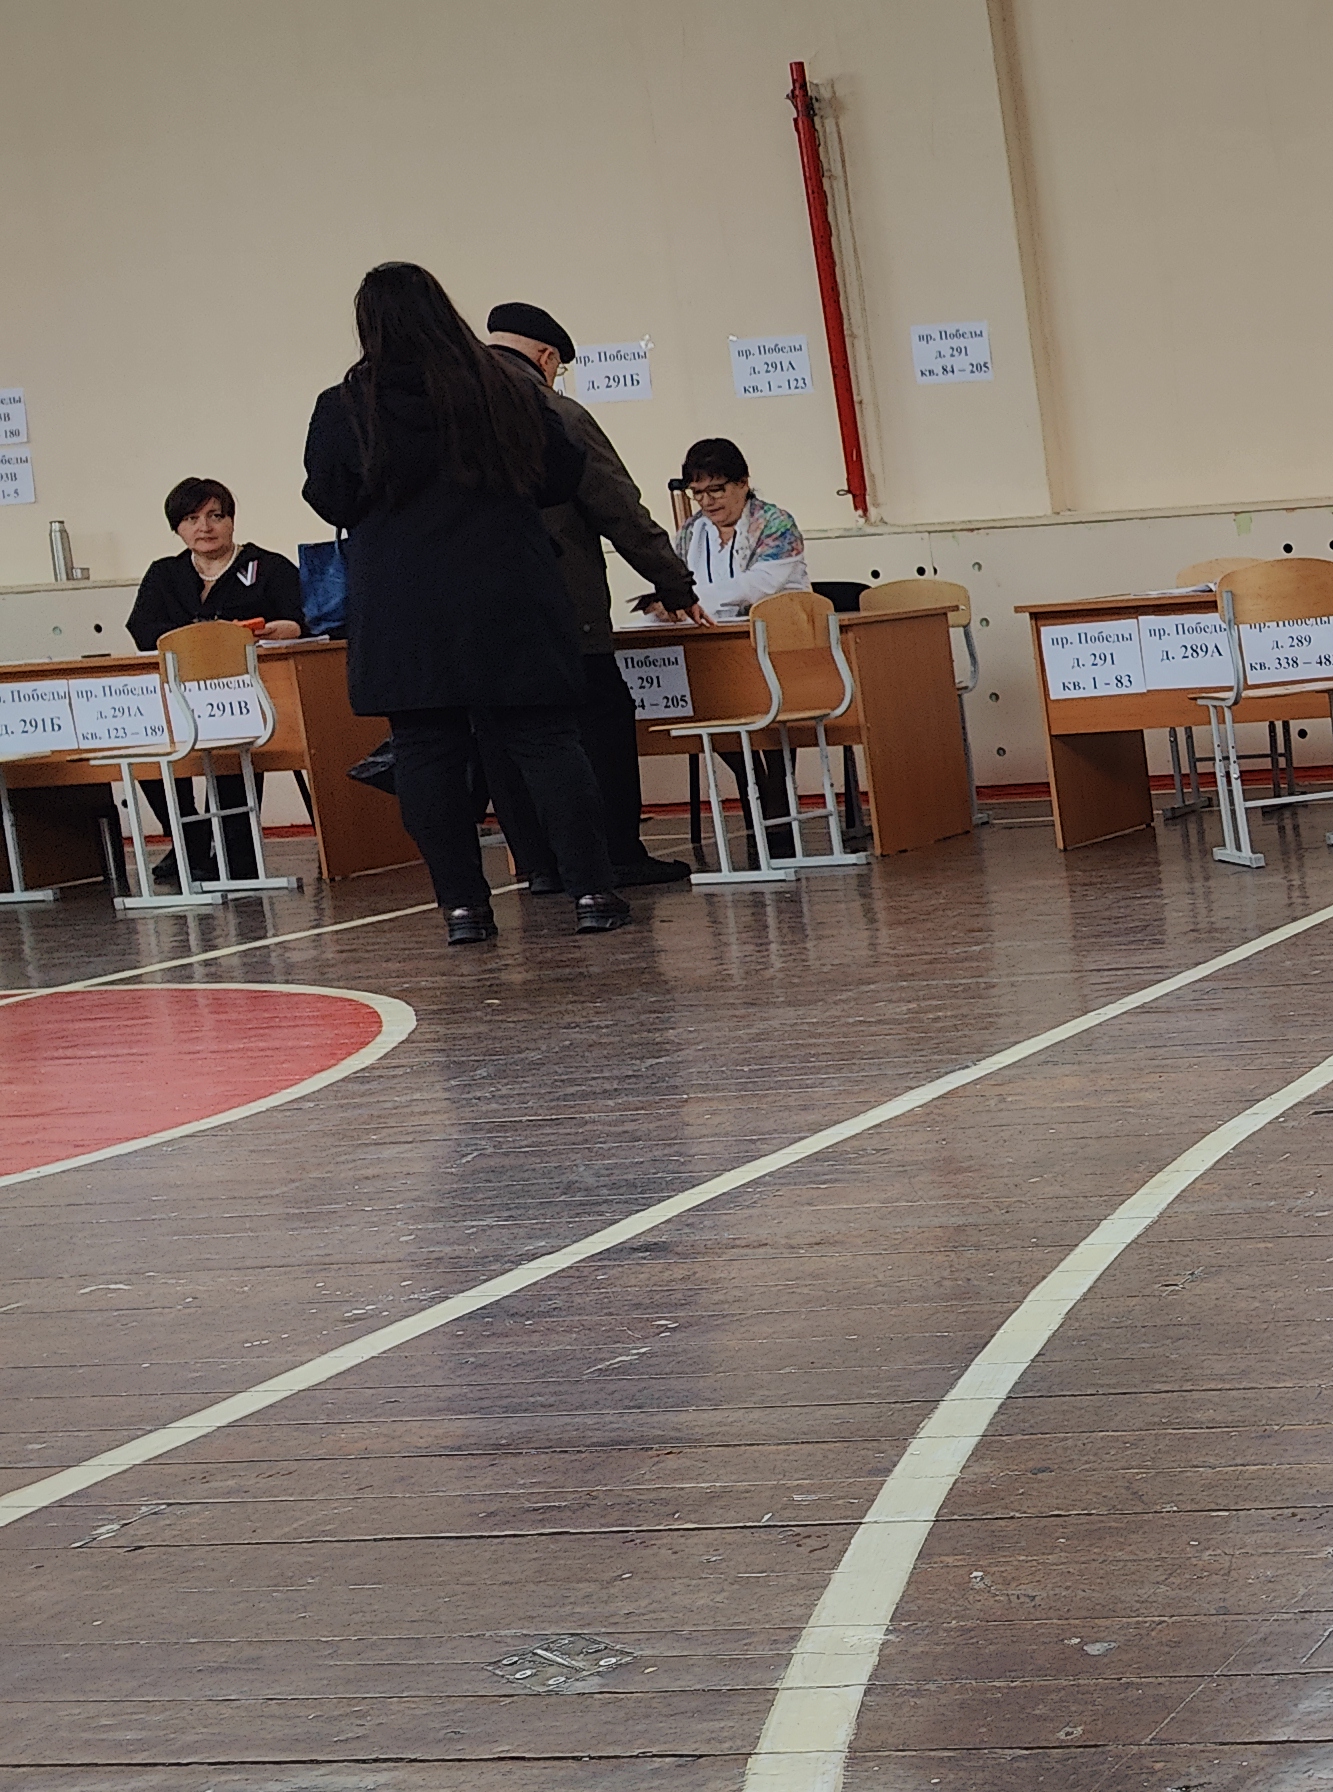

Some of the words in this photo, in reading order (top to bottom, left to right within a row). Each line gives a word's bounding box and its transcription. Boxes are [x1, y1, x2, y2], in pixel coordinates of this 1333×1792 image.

[918, 333, 936, 344] пр.
[939, 328, 983, 341] Победы
[575, 355, 594, 367] пр.
[598, 350, 647, 363] Победы
[737, 349, 755, 360] пр.
[757, 343, 803, 355] Победы
[935, 350, 946, 360] д.
[949, 345, 968, 358] 291
[749, 366, 761, 376] д.
[763, 360, 796, 374] 291А
[919, 367, 939, 377] кв.
[941, 364, 955, 376] 84
[969, 361, 990, 374] 205
[587, 379, 600, 391] д.
[604, 372, 640, 389] 291Б
[743, 385, 763, 395] кв.
[767, 381, 772, 392] 1
[787, 377, 807, 390] 123
[1051, 636, 1073, 649] пр.
[1078, 631, 1133, 644] Победы
[1148, 627, 1171, 640] пр.
[1271, 640, 1284, 651] д.
[1288, 634, 1312, 648] 289
[1071, 658, 1085, 669] д.
[1090, 652, 1115, 666] 291
[1161, 650, 1175, 662] д.
[1180, 643, 1223, 659] 289А
[623, 655, 679, 669] Победы
[1249, 661, 1271, 671] кв.
[1275, 656, 1299, 670] 338
[637, 675, 662, 689] 291
[1062, 681, 1086, 691] кв.
[1092, 676, 1098, 690] 1
[1115, 674, 1133, 688] 83
[11, 688, 67, 703] Победы
[76, 689, 97, 702] пр.
[102, 683, 157, 698] Победы
[662, 694, 688, 708] 205
[96, 710, 107, 721] д.
[110, 705, 144, 719] 291А
[206, 700, 250, 718] 291В
[19, 715, 62, 734] 291Б
[81, 731, 102, 741] кв.
[107, 726, 127, 739] 123
[143, 724, 165, 737] 189
